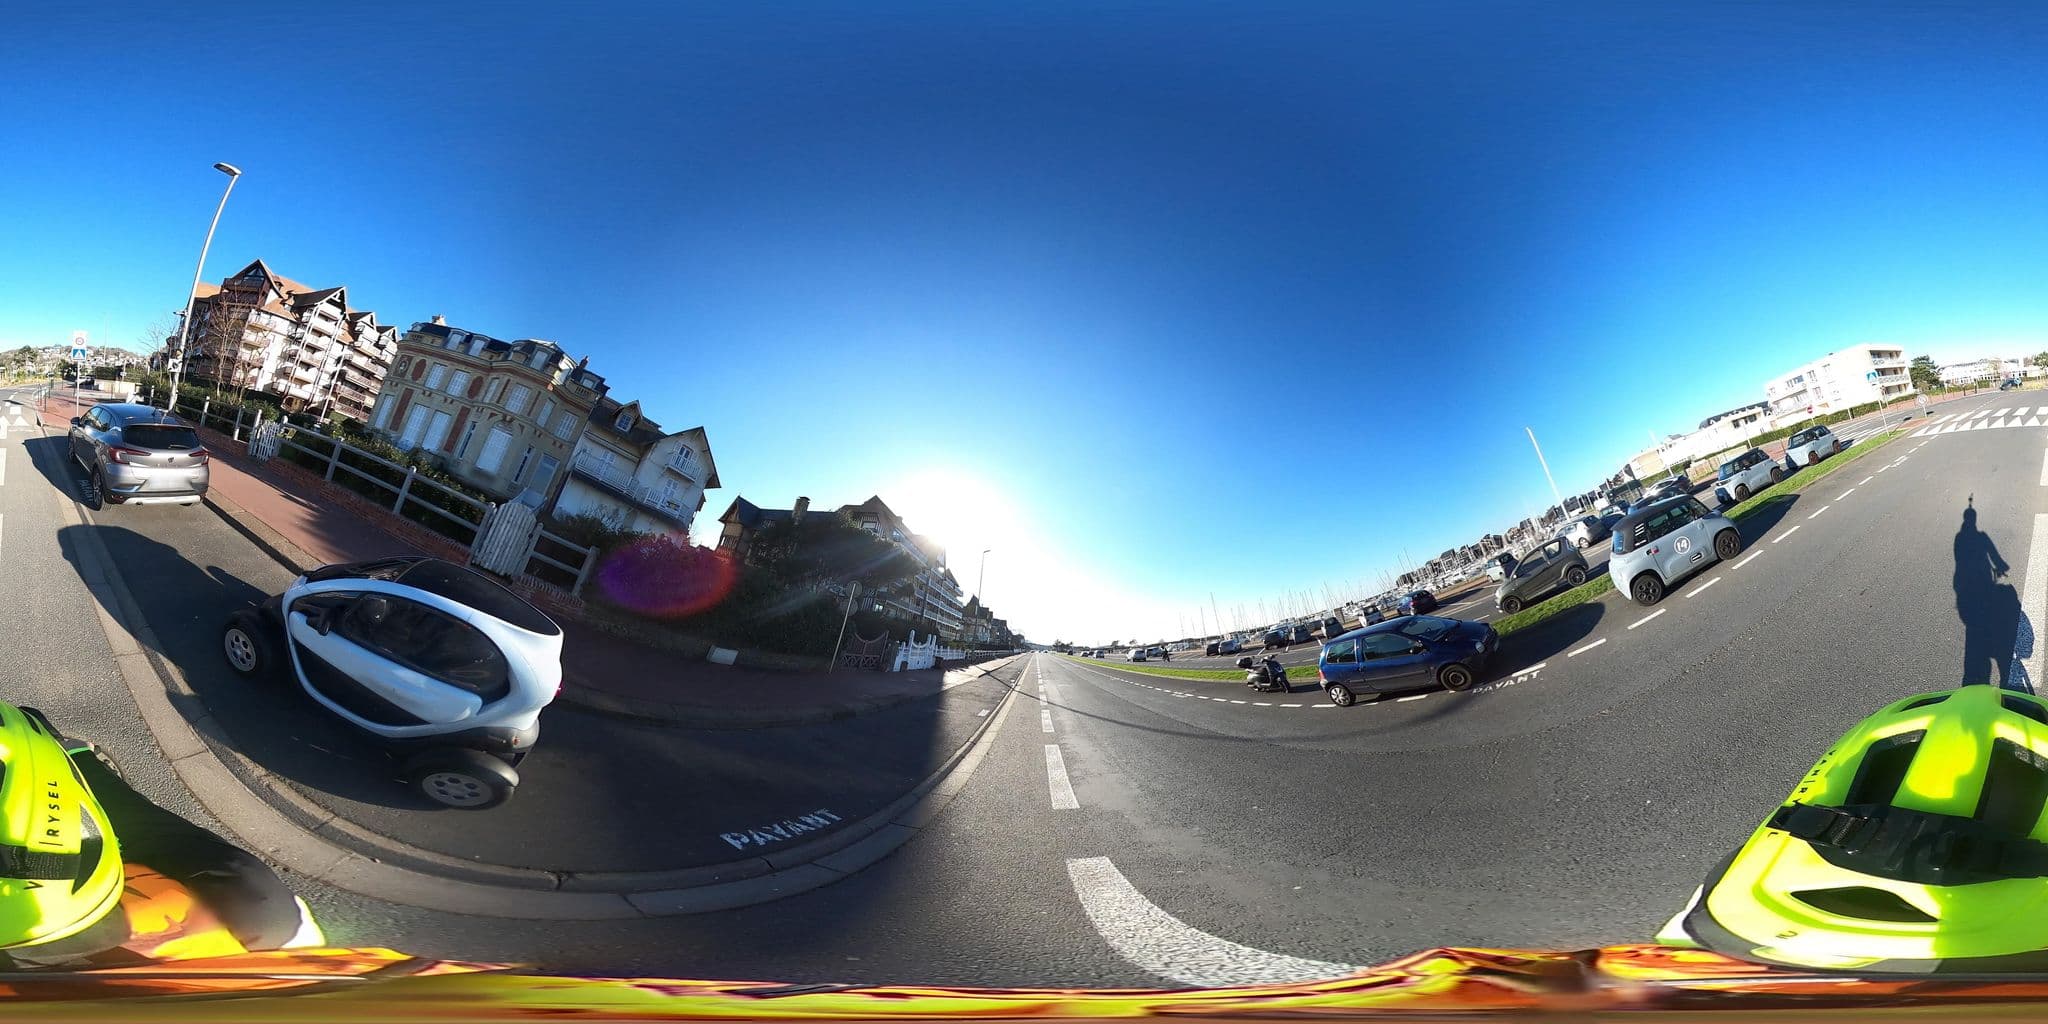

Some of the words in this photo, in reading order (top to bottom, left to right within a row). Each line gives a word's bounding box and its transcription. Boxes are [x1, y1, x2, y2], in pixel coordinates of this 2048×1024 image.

[1676, 539, 1688, 552] 14
[1472, 671, 1541, 694] PAYANT
[46, 780, 61, 838] RYSEL
[719, 808, 843, 850] PAYANT
